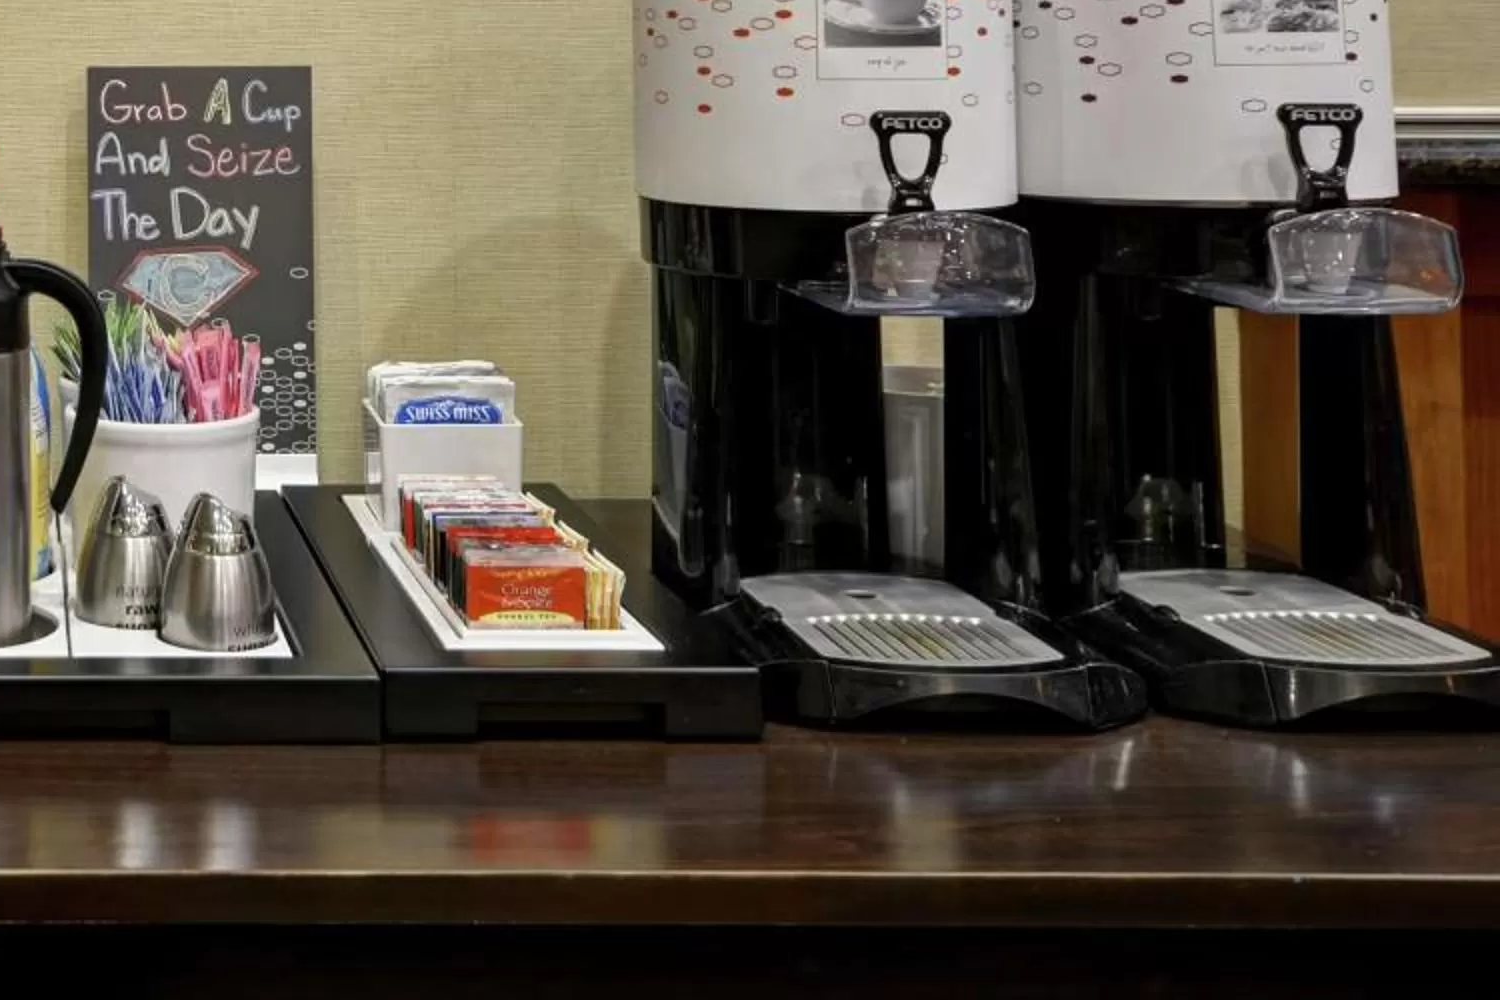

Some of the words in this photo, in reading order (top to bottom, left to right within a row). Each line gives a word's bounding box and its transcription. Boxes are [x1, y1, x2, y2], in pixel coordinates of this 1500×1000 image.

[100, 79, 188, 124] Grab
[203, 77, 232, 125] A
[241, 79, 302, 132] Cup
[881, 116, 943, 130] FETCO
[1291, 107, 1357, 121] FETCO
[94, 131, 171, 177] And
[186, 133, 301, 178] Seize
[90, 187, 162, 241] The
[169, 186, 261, 250] Day
